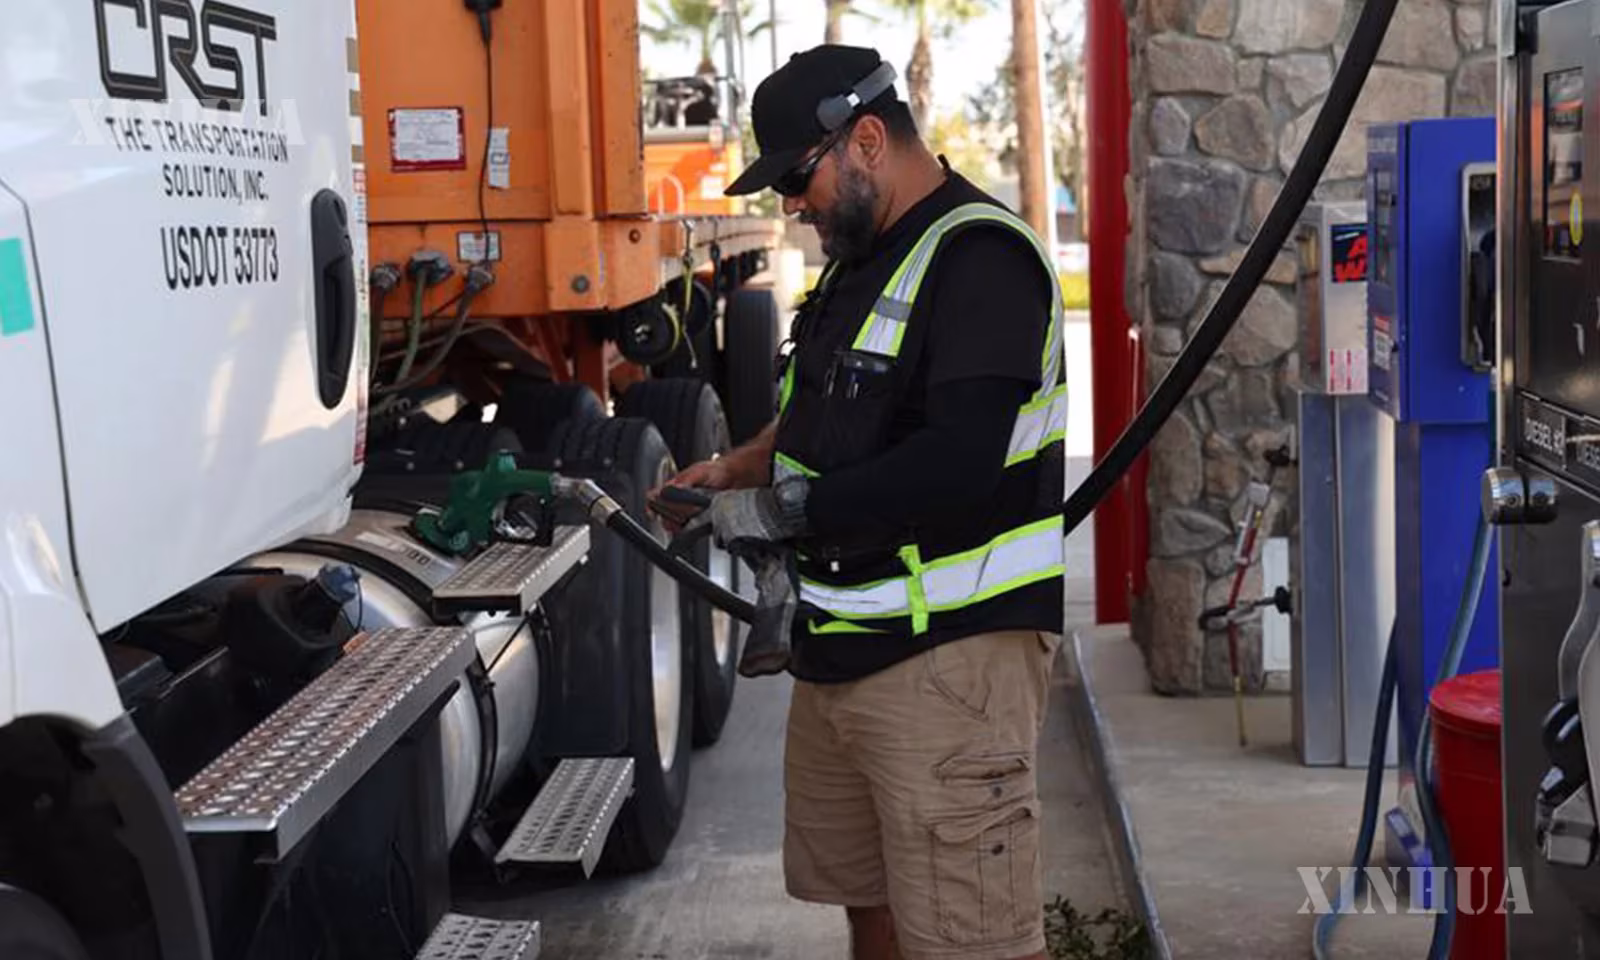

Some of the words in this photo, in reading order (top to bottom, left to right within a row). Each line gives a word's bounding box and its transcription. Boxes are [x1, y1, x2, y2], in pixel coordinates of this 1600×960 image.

[93, 0, 276, 117] CRST
[105, 117, 152, 151] THE
[152, 119, 289, 163] TRANSPORTATION
[243, 169, 269, 200] INC.
[160, 226, 228, 290] USDOT
[233, 227, 279, 286] 53773
